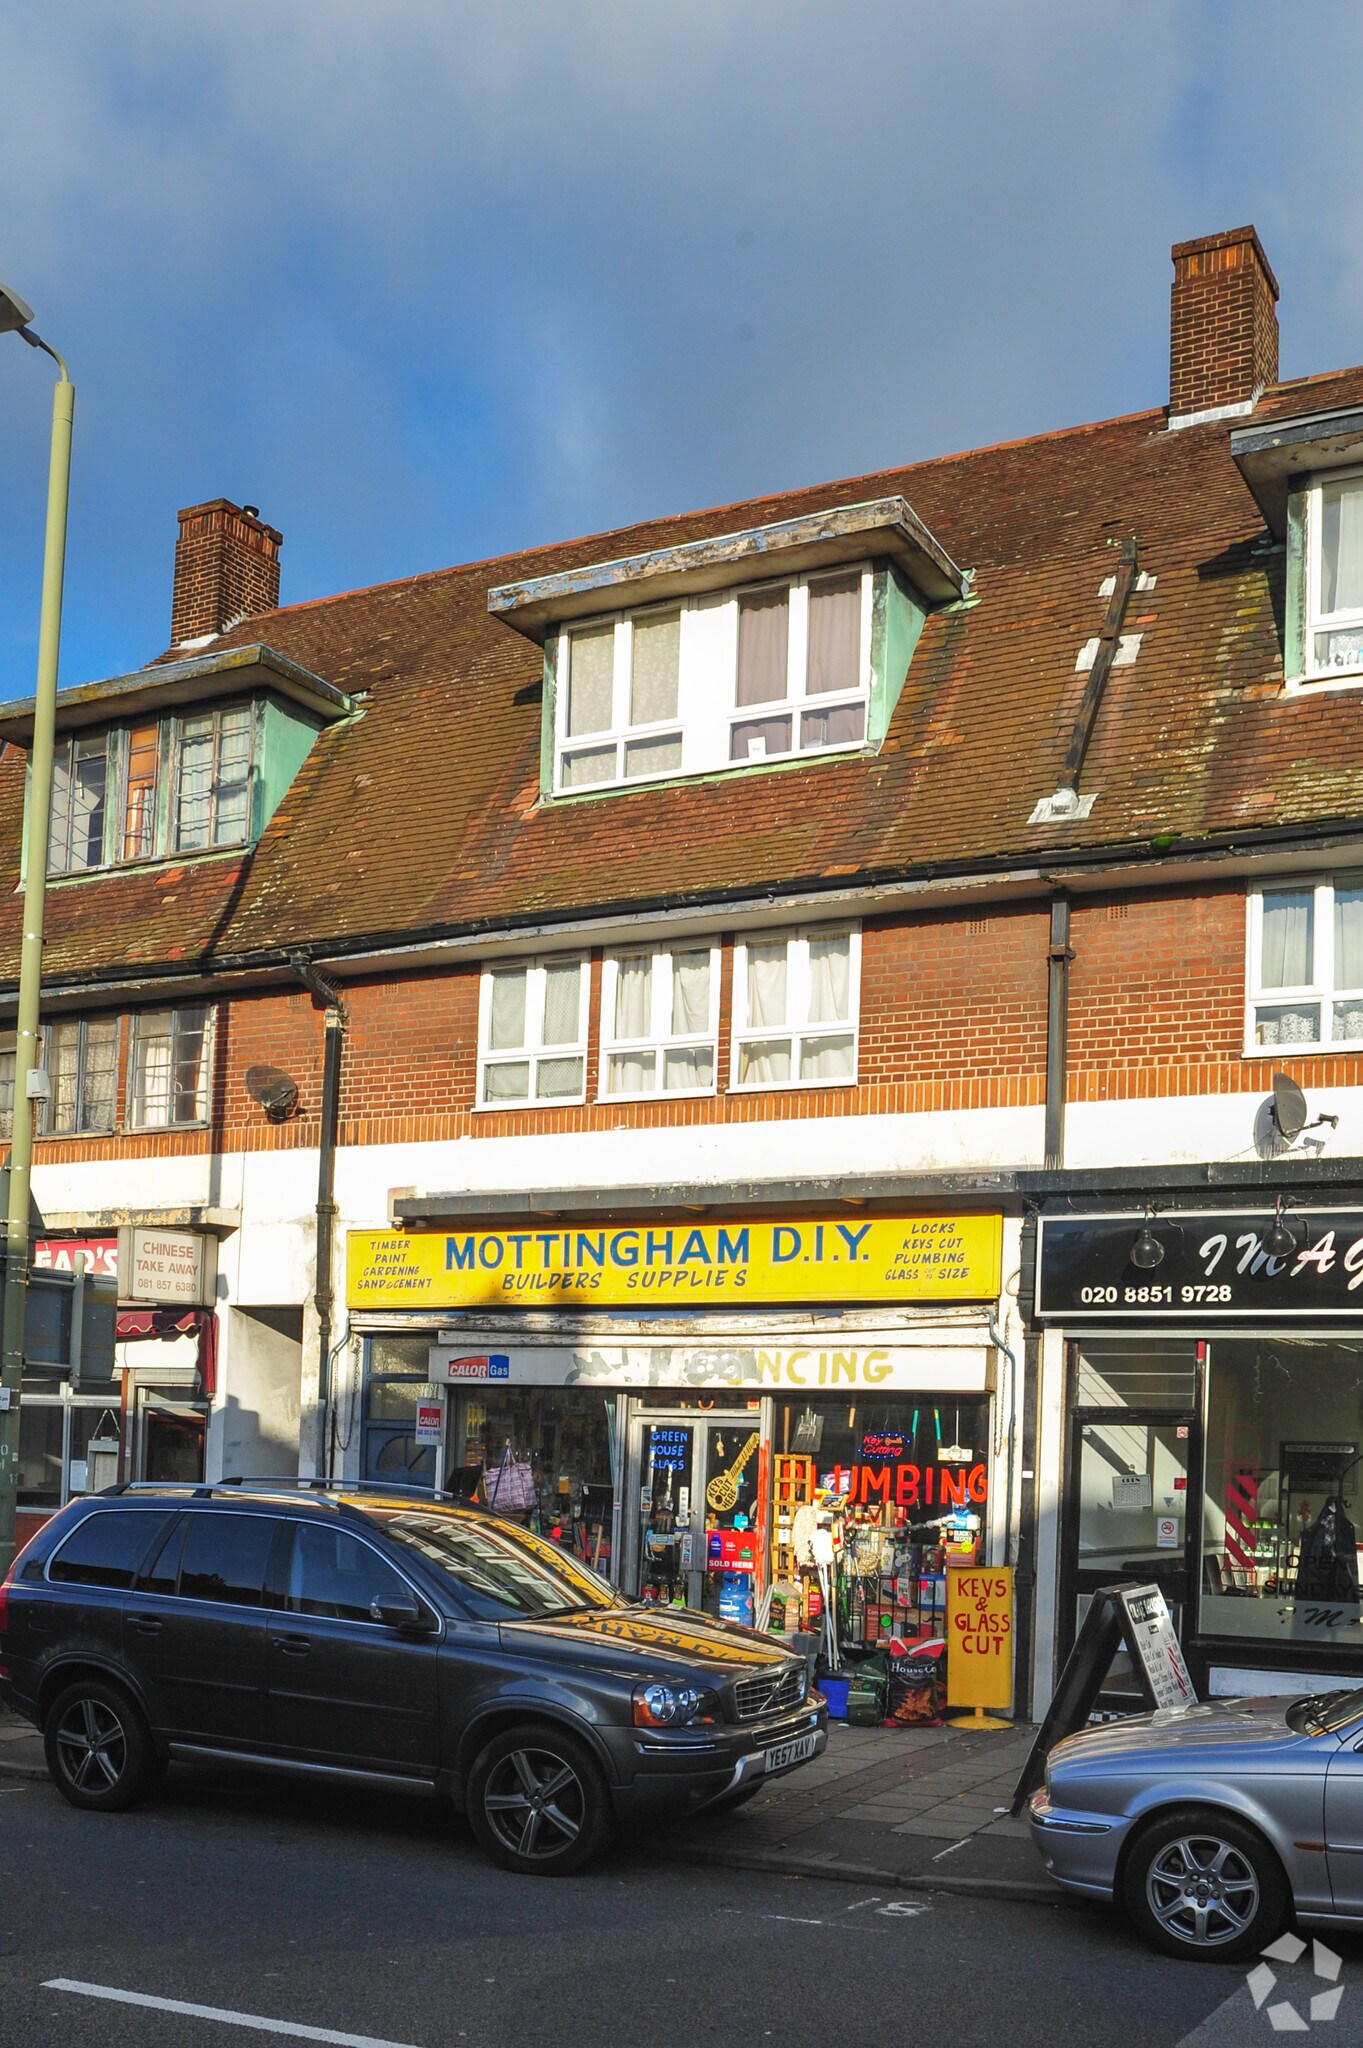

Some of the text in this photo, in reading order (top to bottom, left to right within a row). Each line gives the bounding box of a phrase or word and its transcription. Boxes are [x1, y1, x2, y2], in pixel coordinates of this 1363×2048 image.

[911, 1223, 956, 1234] LOCKS
[370, 1240, 411, 1250] TIMBER
[445, 1223, 873, 1270] MOTTINGHAM D.I.Y.
[902, 1238, 964, 1249] KEYS CUT
[142, 1242, 194, 1259] CHINESE
[374, 1253, 407, 1263] PAINT
[894, 1252, 965, 1264] PLUMBING
[136, 1259, 198, 1276] TAKE AWAY
[363, 1266, 419, 1276] GARDENING
[885, 1268, 919, 1280] GLASS
[938, 1267, 970, 1279] SIZE
[502, 1269, 748, 1290] BUILDERS SUPPLIES
[138, 1279, 197, 1293] 081 857 6380
[1081, 1285, 1232, 1303] 020 8851 9728
[450, 1365, 508, 1377] CALOR Gas
[420, 1417, 440, 1426] CALOR
[651, 1431, 688, 1442] GREEN
[863, 1436, 882, 1446] Key
[649, 1445, 684, 1456] HOUSE
[864, 1445, 903, 1456] Cutting
[649, 1460, 685, 1470] GLASS
[708, 1479, 724, 1498] KEYS
[719, 1479, 733, 1498] CUT
[722, 1490, 737, 1509] HERE
[709, 1560, 754, 1569] SOLD HERE
[958, 1578, 1007, 1598] KEYS
[975, 1597, 988, 1612] &
[954, 1613, 1011, 1633] GLASS
[962, 1635, 1004, 1655] CUT
[891, 1662, 923, 1673] House
[770, 1739, 810, 1768] YE57 XAV
